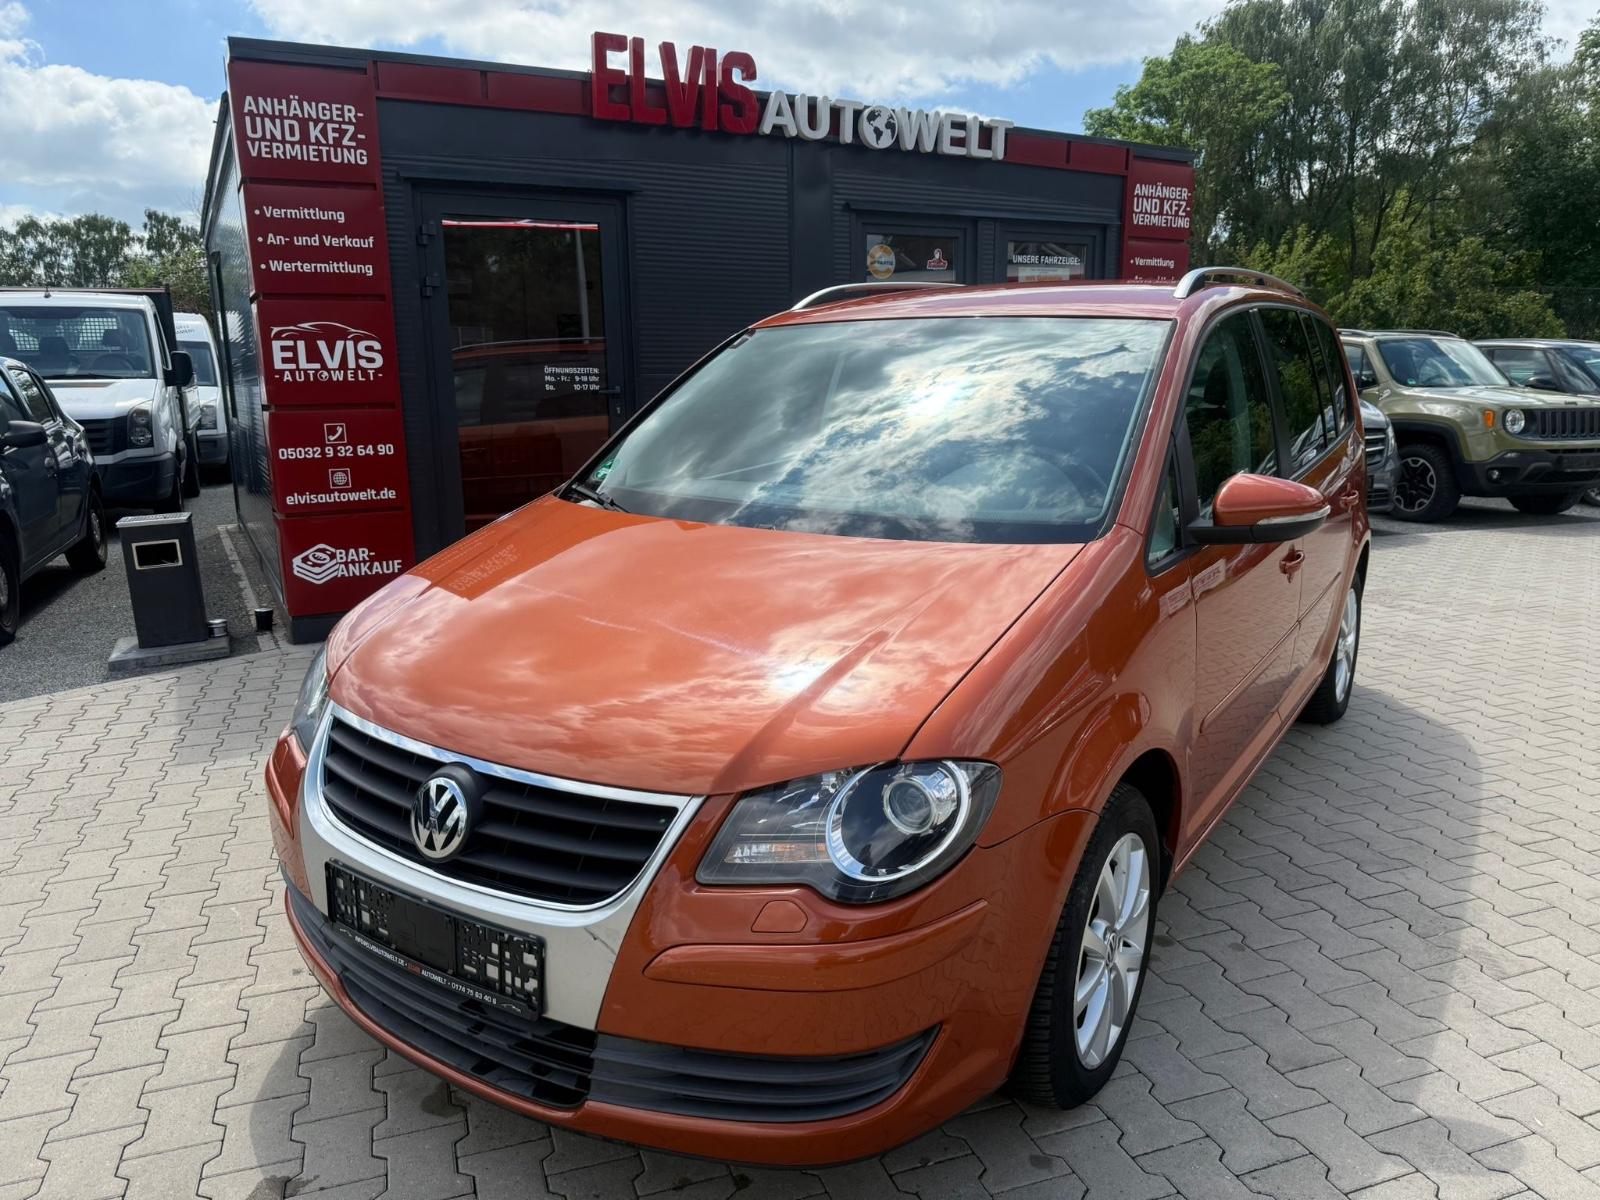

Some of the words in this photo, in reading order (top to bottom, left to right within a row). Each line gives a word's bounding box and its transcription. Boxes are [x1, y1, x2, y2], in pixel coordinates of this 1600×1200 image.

[591, 31, 759, 135] ELVIS
[243, 94, 364, 123] ANHÄNGER-
[244, 116, 300, 142] UND
[309, 121, 366, 147] KFZ-
[758, 89, 1015, 161] AUTOWELT
[247, 140, 368, 165] VERMIETUNG
[1134, 182, 1191, 200] ANHÄNGER-
[263, 206, 345, 224] Vermittlung
[1133, 198, 1160, 214] UND
[1163, 200, 1191, 215] KFZ-
[1132, 213, 1190, 228] VERMIETUNG
[267, 233, 290, 246] An-
[293, 234, 320, 247] und
[323, 235, 374, 249] Verkauf
[269, 259, 373, 276] Wertermittlung
[1012, 255, 1039, 264] UNSERE
[1041, 256, 1081, 265] FAHRZEUGE:
[1134, 257, 1175, 269] Vermittlung
[271, 339, 384, 370] ELVIS
[544, 366, 600, 374] ÖFFNUNGSZEITEN:
[278, 446, 322, 460] 05032
[325, 445, 334, 458] 9
[337, 444, 353, 458] 32
[357, 444, 375, 457] 64
[377, 443, 394, 456] 90
[286, 487, 397, 505] elvisautowelt.de
[336, 548, 376, 563] BAR-
[336, 559, 402, 577] ANKAUF
